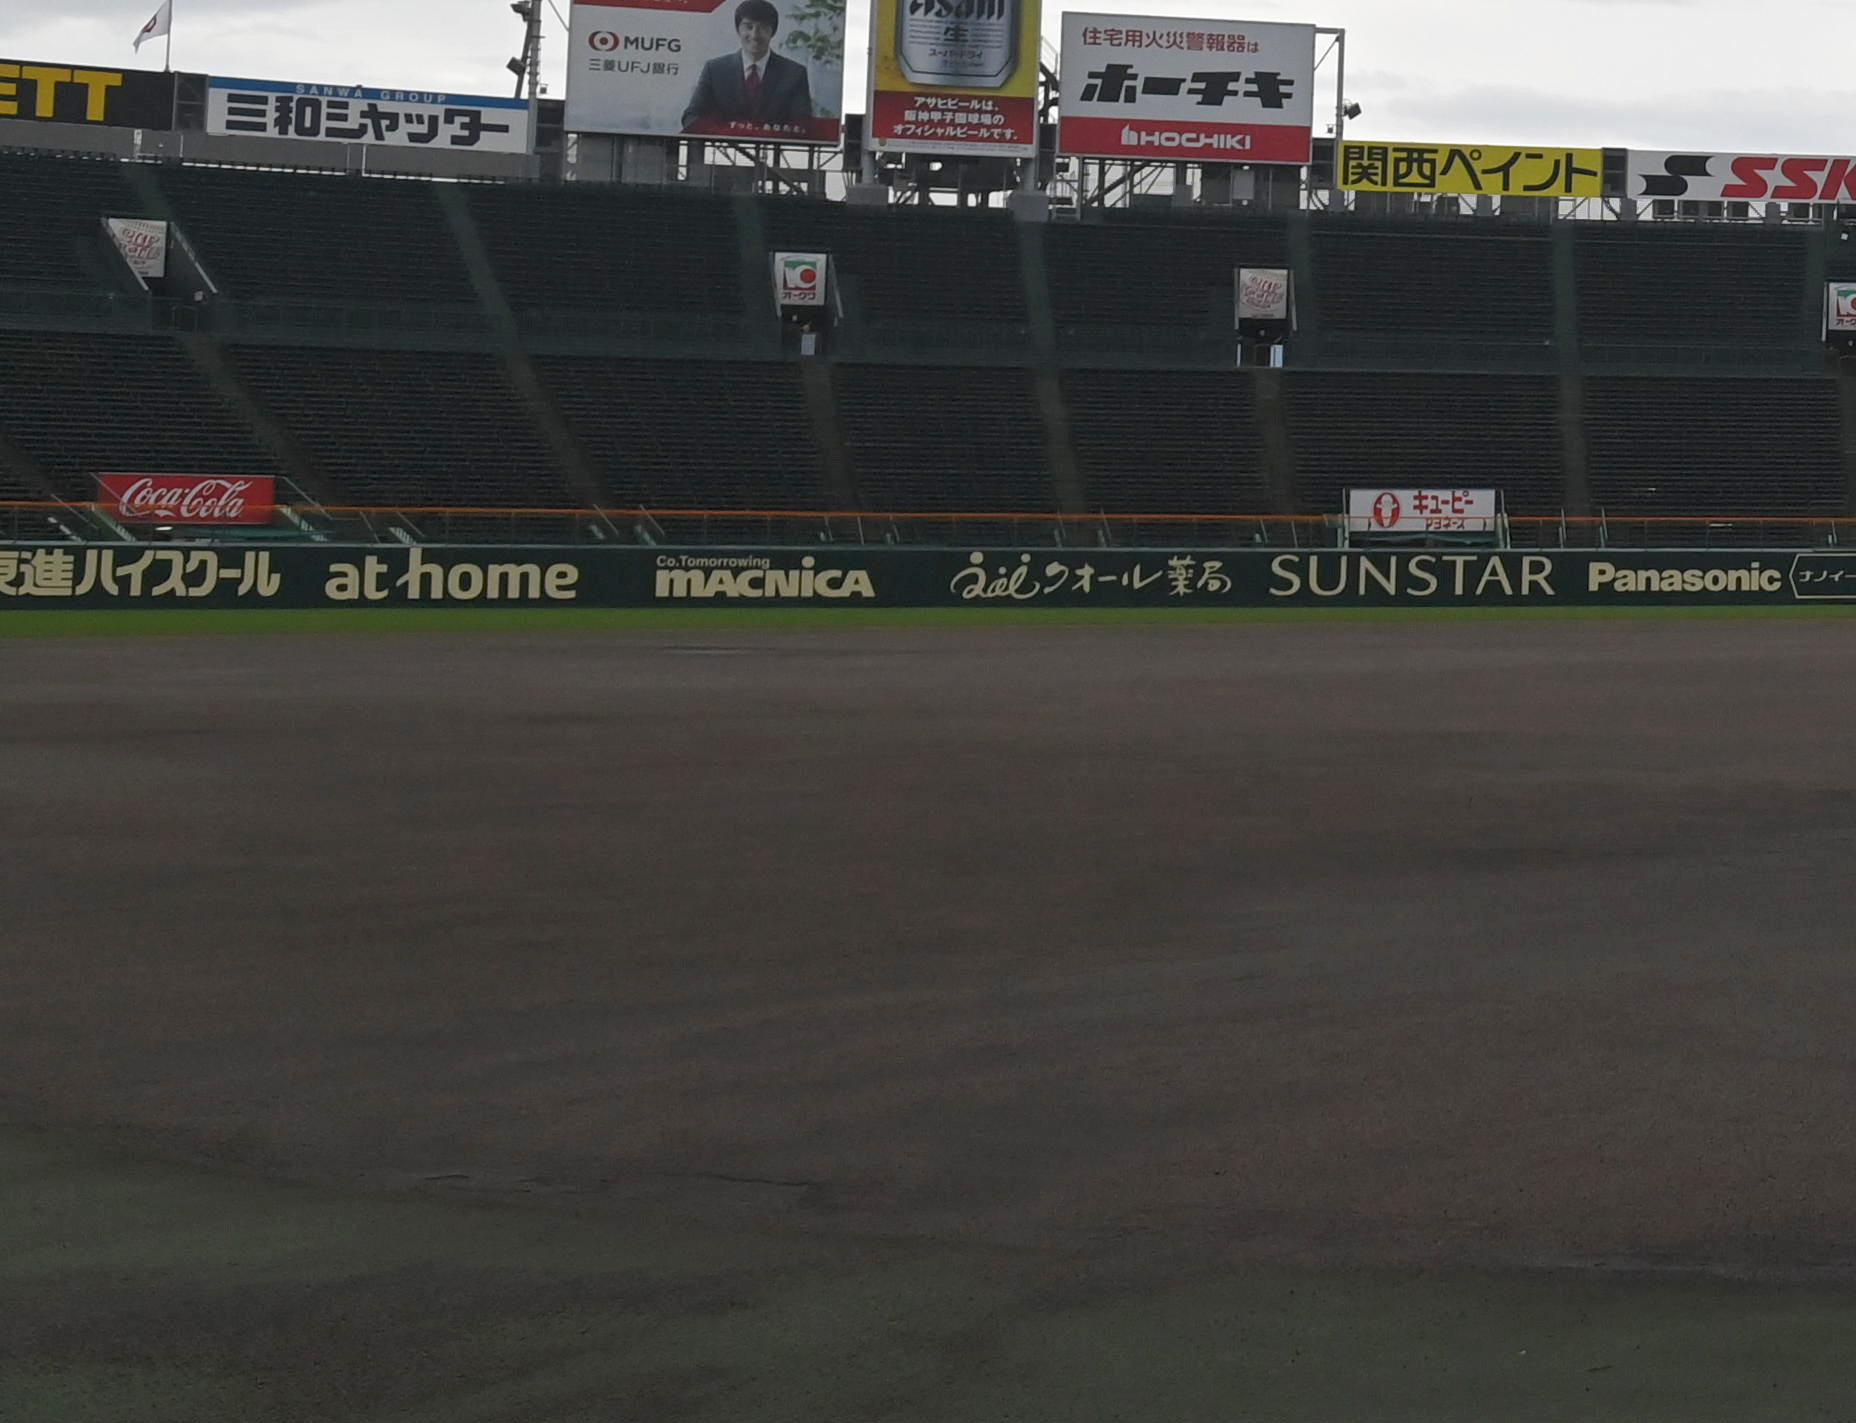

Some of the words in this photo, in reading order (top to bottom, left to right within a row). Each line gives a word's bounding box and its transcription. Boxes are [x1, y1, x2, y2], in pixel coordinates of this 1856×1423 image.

[624, 35, 682, 53] MUFG
[1081, 27, 1260, 54] 住宅用火災警報器は
[588, 58, 680, 76] 三菱UFJ銀行
[295, 83, 364, 99] SANWA
[380, 90, 447, 104] GROUP
[1079, 63, 1295, 109] ホーチキ
[225, 92, 510, 146] 三和シャッター
[1140, 130, 1251, 151] HOCHIKI
[1342, 145, 1599, 193] 関西ペイント
[119, 477, 252, 519] Coca-Cola
[1413, 489, 1474, 515] キューピー
[324, 555, 390, 600] at
[396, 548, 578, 601] home
[1044, 555, 1233, 597] クオール薬局
[1269, 555, 1556, 597] SUNSTAR
[1588, 561, 1783, 592] Panasonic
